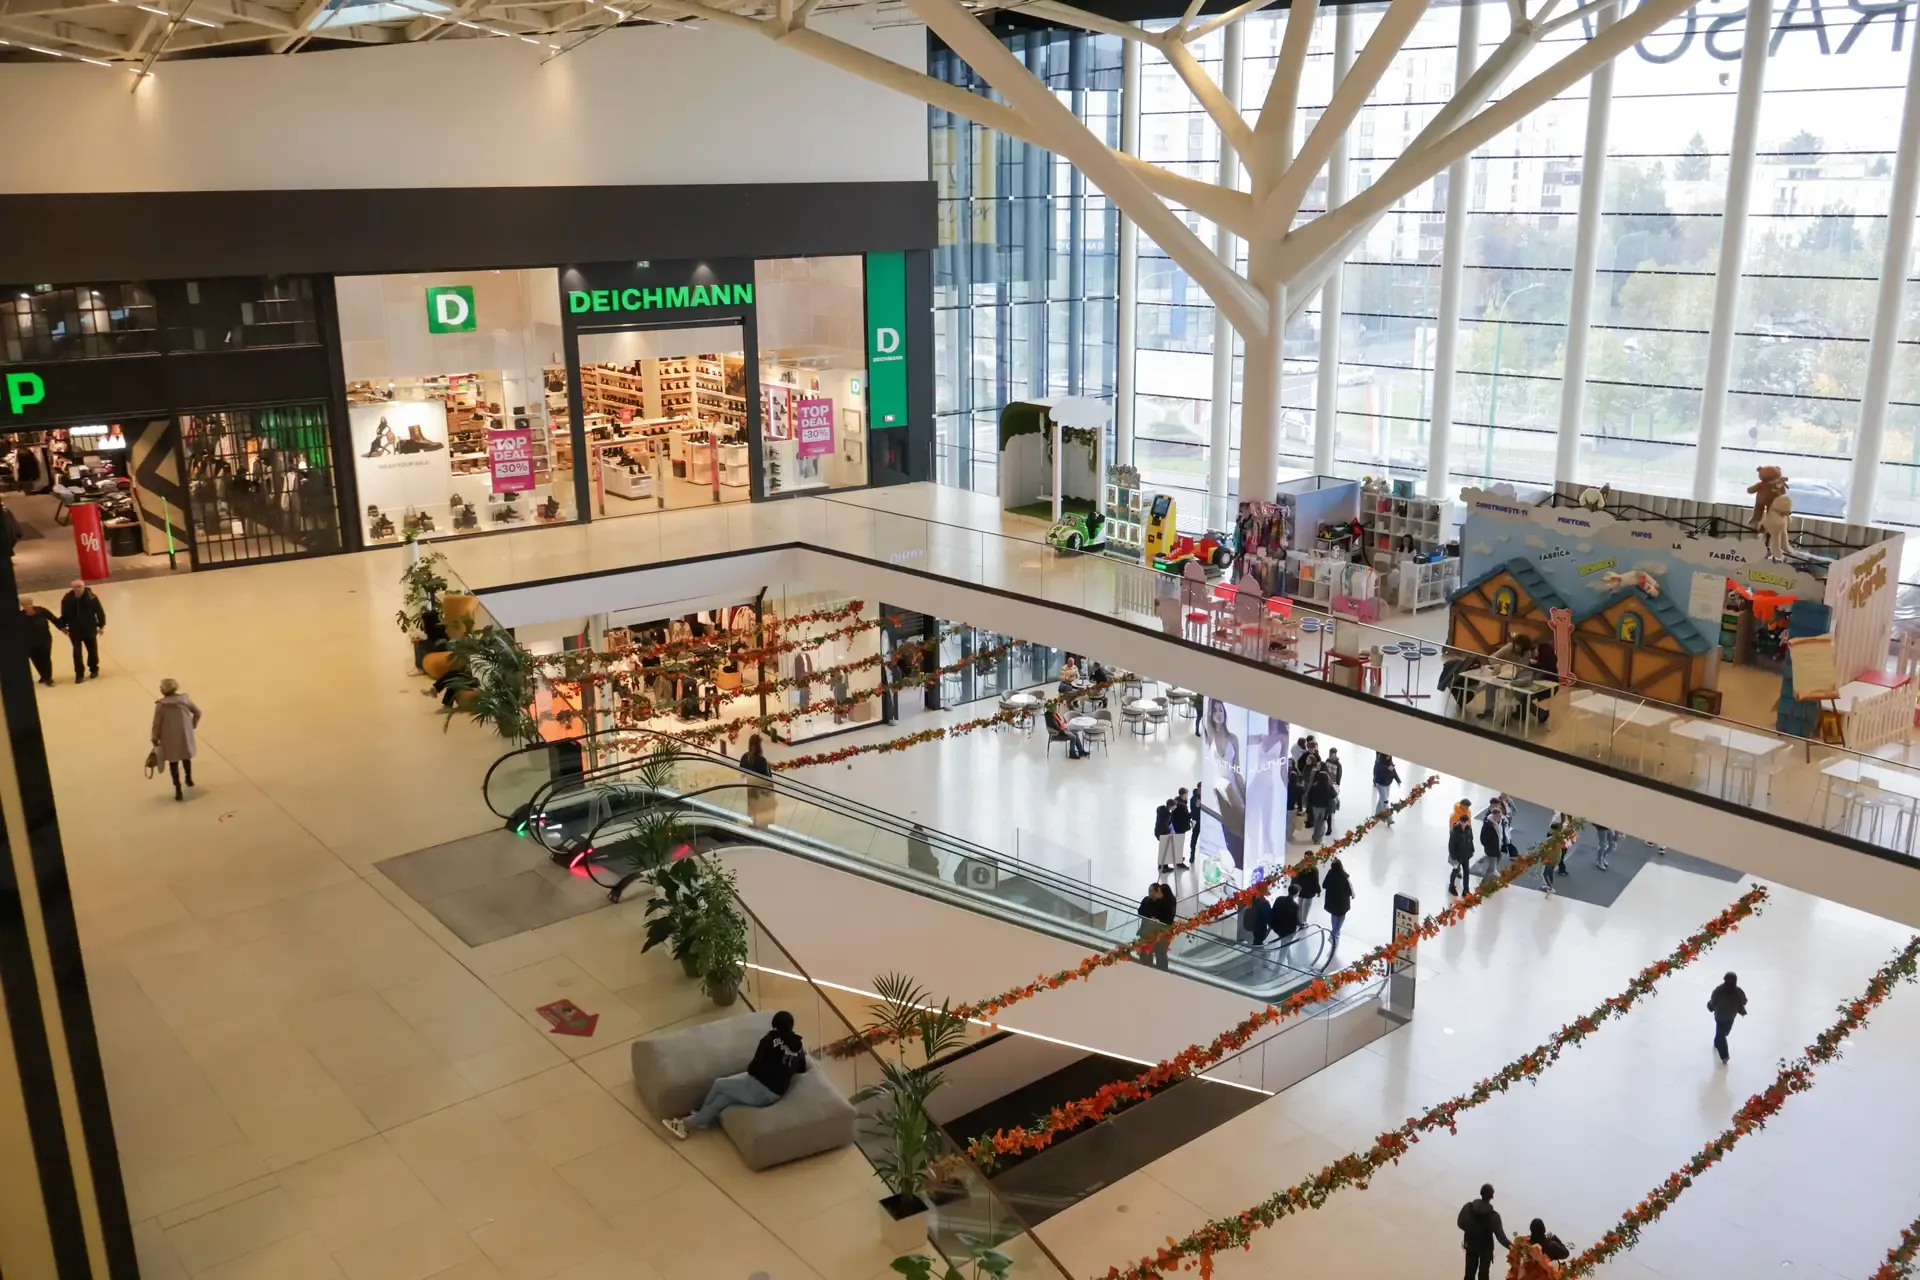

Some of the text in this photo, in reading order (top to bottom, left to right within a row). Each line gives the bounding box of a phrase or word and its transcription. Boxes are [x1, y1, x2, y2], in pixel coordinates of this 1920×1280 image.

[568, 283, 753, 313] DEICHMANN
[436, 294, 469, 325] D
[877, 327, 900, 353] D
[873, 355, 904, 363] DEICHMANN
[852, 381, 860, 392] D
[0, 372, 45, 414] P
[801, 405, 829, 417] TOP
[801, 417, 830, 427] DEAL
[803, 429, 829, 439] -30%
[492, 436, 527, 450] TOP
[493, 449, 529, 461] DEAL
[497, 463, 528, 473] -30%
[1539, 550, 1571, 561] FABRICA
[1672, 542, 1682, 550] LA
[1709, 551, 1746, 563] FABRICA
